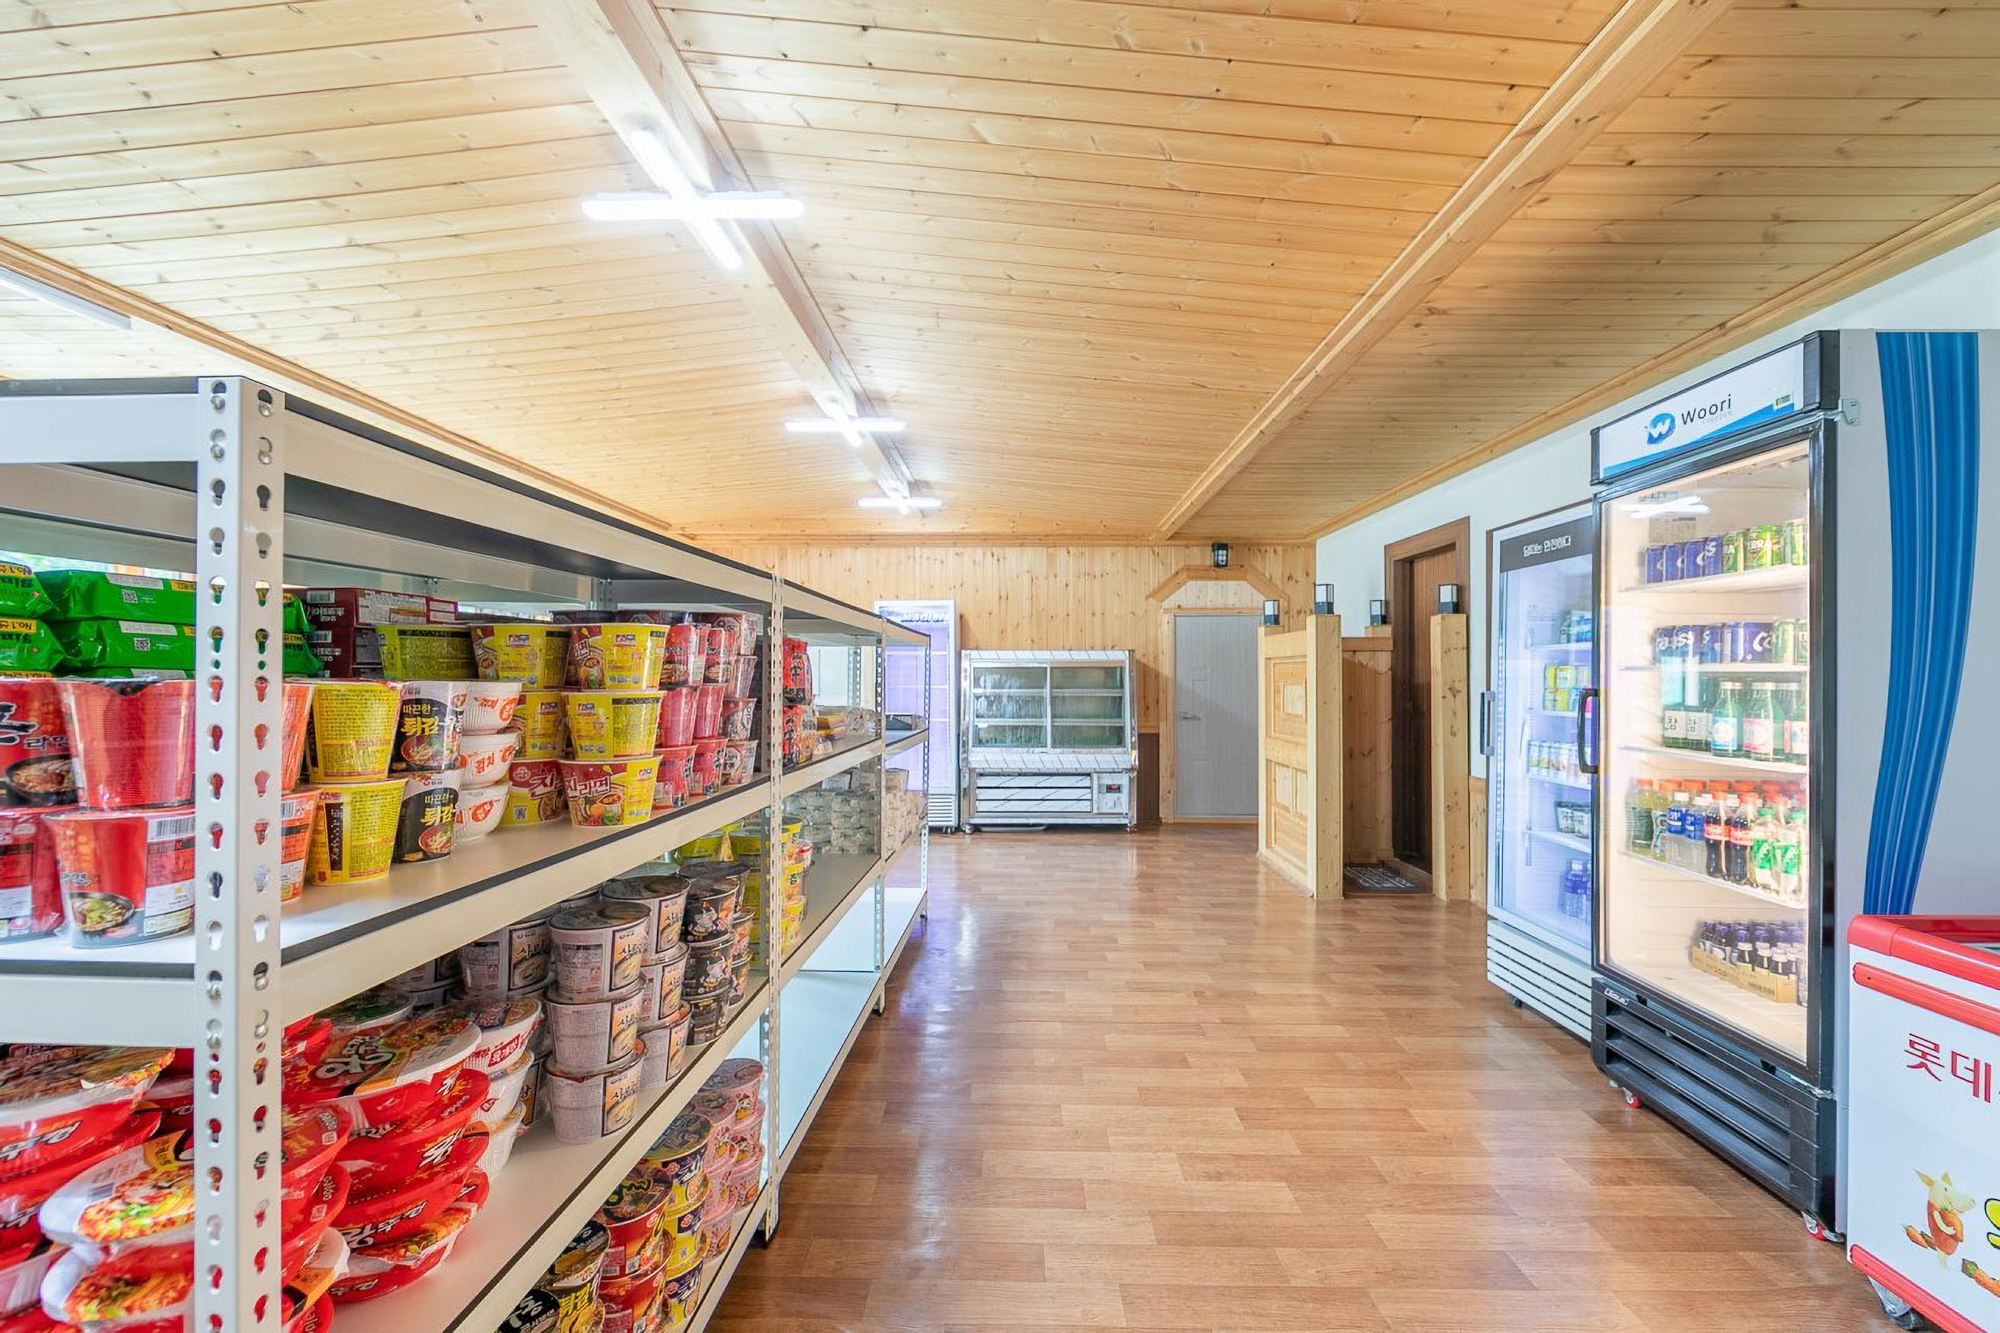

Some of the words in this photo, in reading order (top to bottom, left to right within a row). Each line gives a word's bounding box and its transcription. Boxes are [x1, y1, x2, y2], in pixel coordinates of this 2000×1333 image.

[1681, 393, 1732, 426] Woori
[564, 775, 612, 801] 진라면
[1902, 1032, 2000, 1105] 롯데
